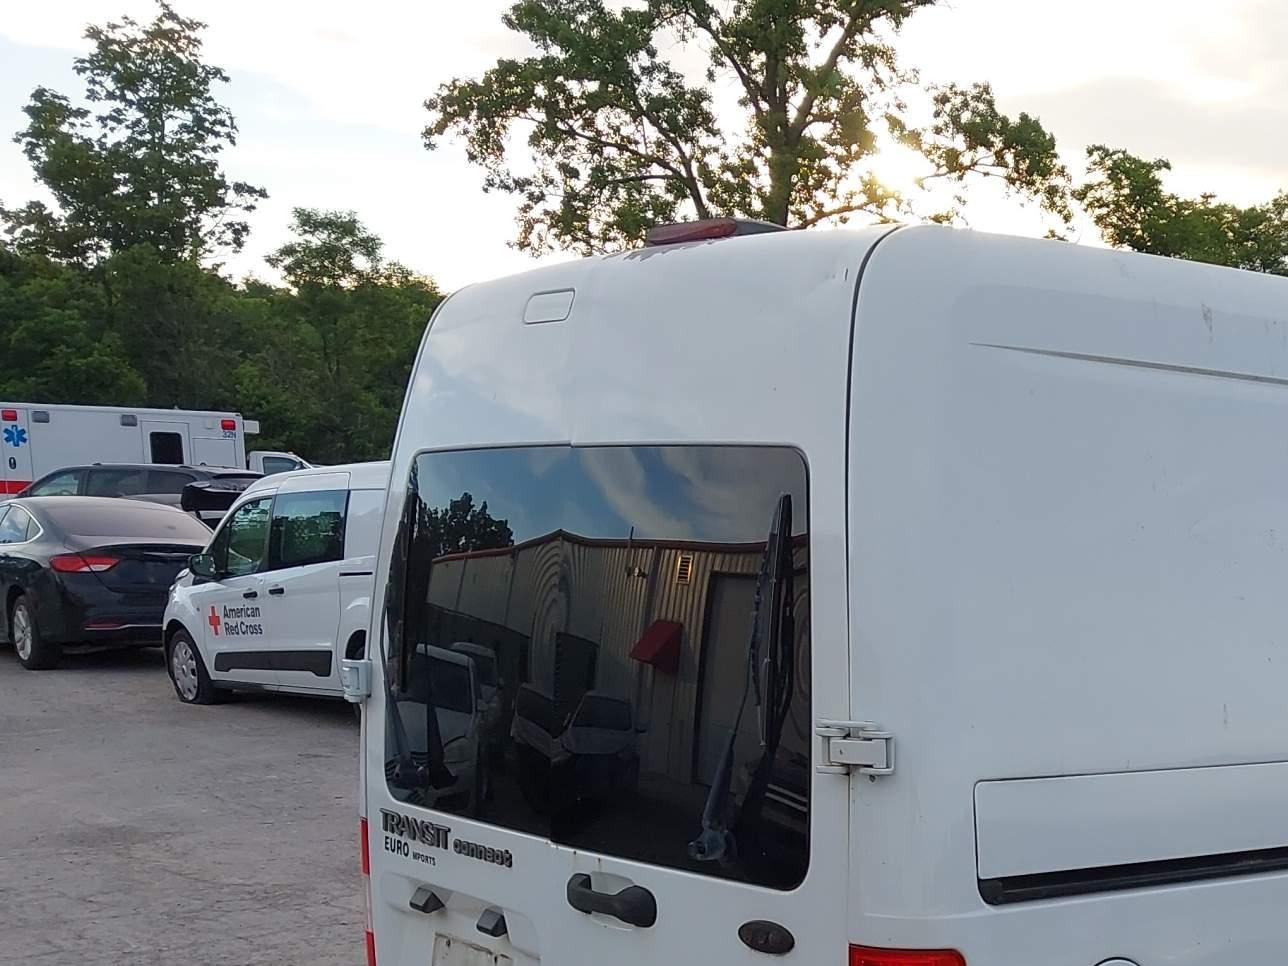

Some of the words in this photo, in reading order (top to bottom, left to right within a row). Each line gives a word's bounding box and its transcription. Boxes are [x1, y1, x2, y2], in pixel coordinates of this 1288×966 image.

[223, 604, 261, 619] American
[224, 621, 240, 636] Red
[239, 620, 263, 636] Cross
[379, 807, 451, 850] TRANSIT
[453, 838, 513, 869] connect
[384, 835, 410, 858] EURO
